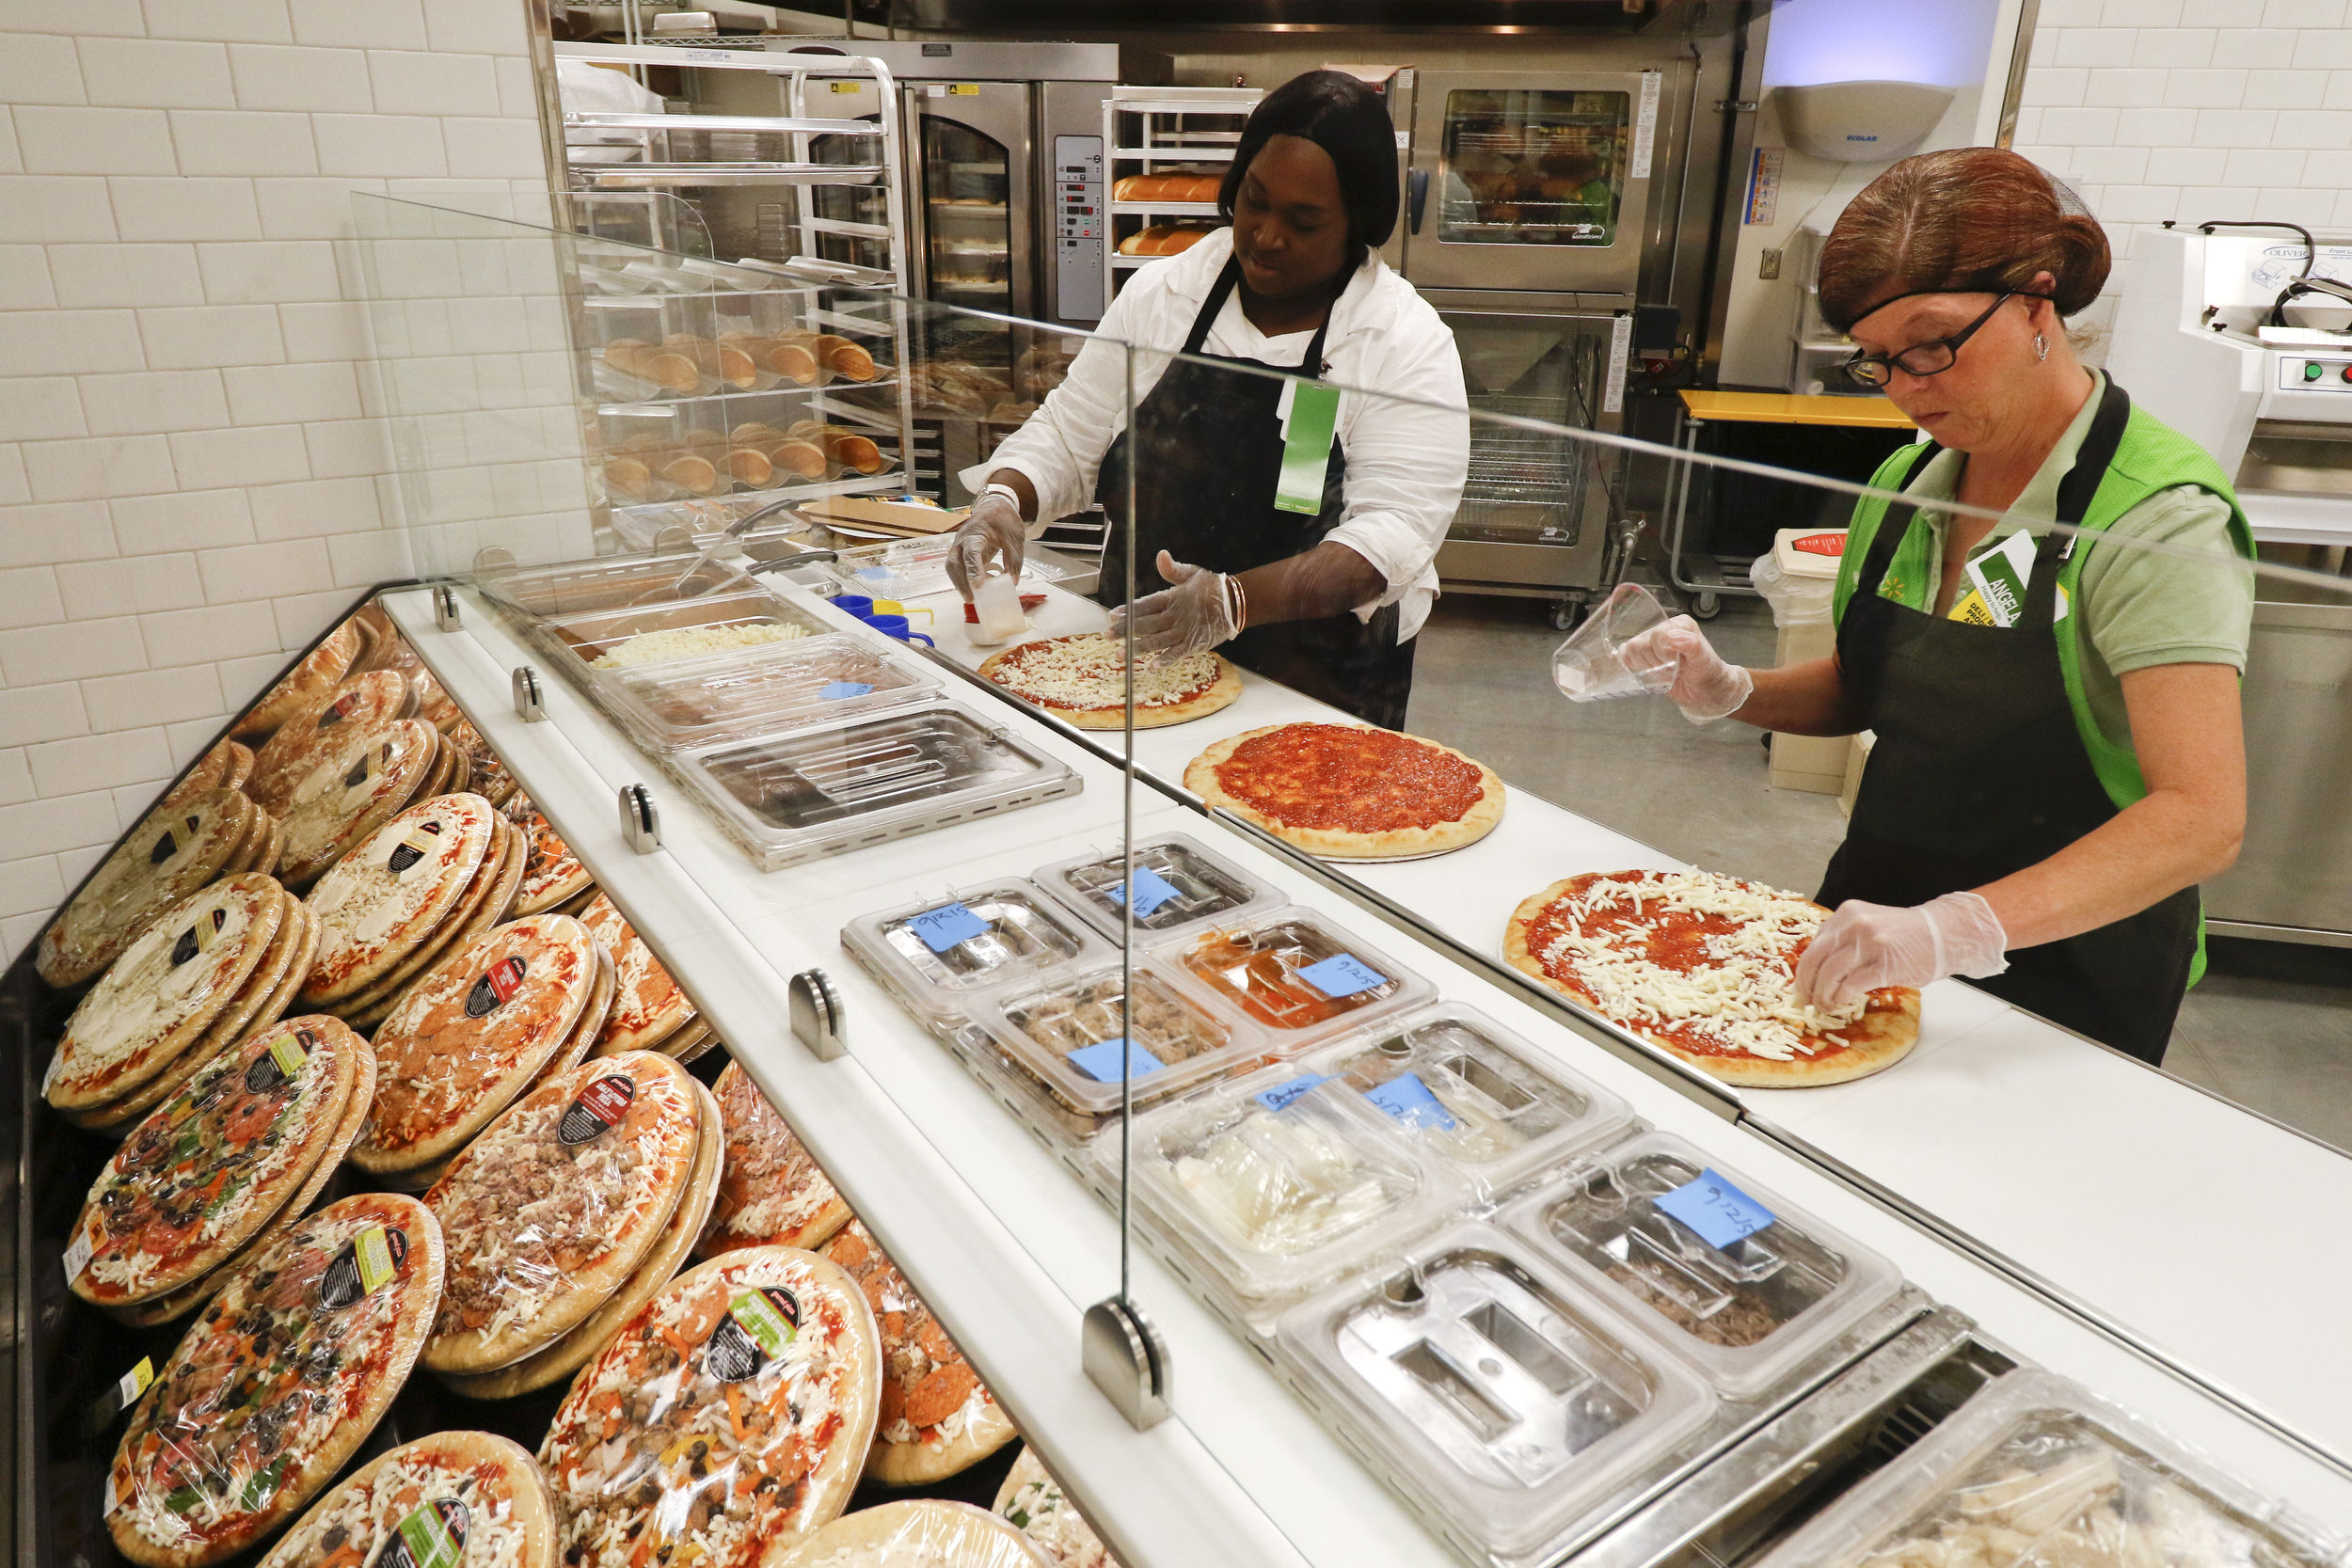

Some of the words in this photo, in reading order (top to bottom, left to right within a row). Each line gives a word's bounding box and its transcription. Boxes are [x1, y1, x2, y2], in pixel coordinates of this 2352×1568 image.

[1980, 585, 1993, 604] Happy
[1989, 600, 1995, 609] to
[1989, 578, 2022, 624] ANGELA
[1970, 602, 1985, 617] DELI
[1966, 610, 1988, 626] PROD
[783, 1301, 796, 1316] pizza
